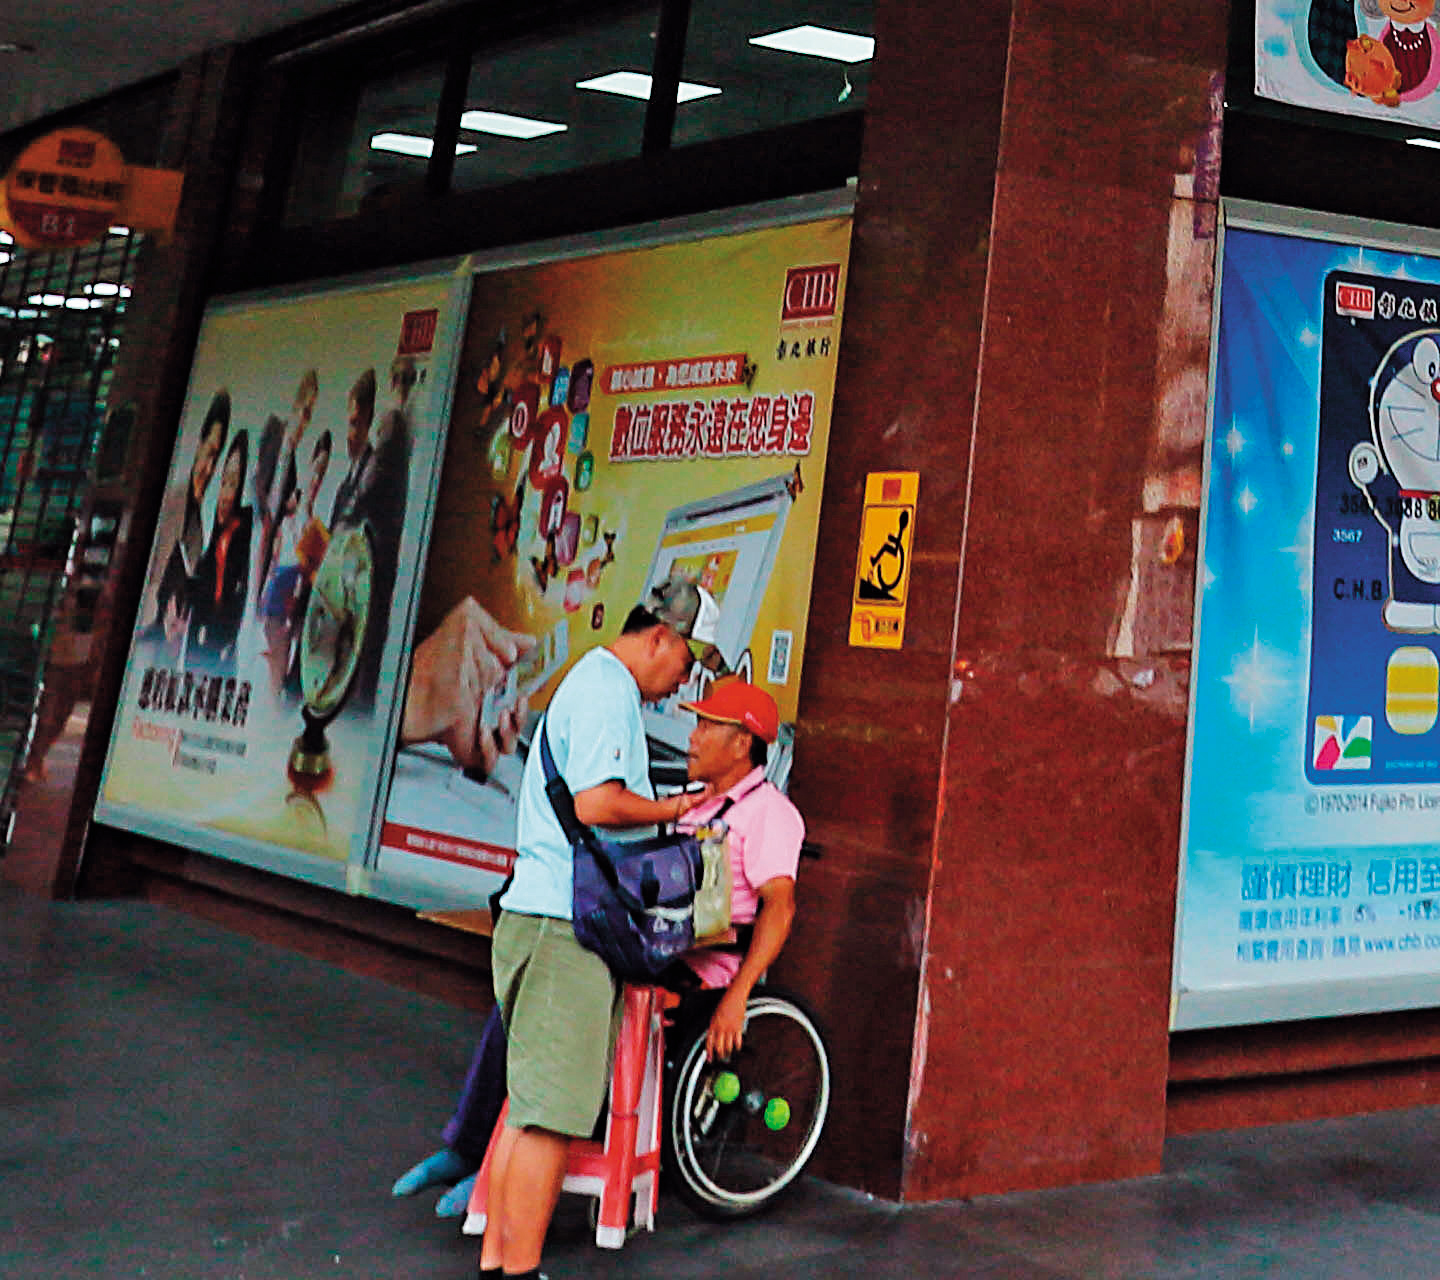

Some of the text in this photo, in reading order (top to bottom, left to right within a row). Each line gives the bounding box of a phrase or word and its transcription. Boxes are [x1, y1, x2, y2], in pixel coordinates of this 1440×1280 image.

[786, 271, 835, 312] CHB
[1240, 860, 1352, 901] 謹慎理財
